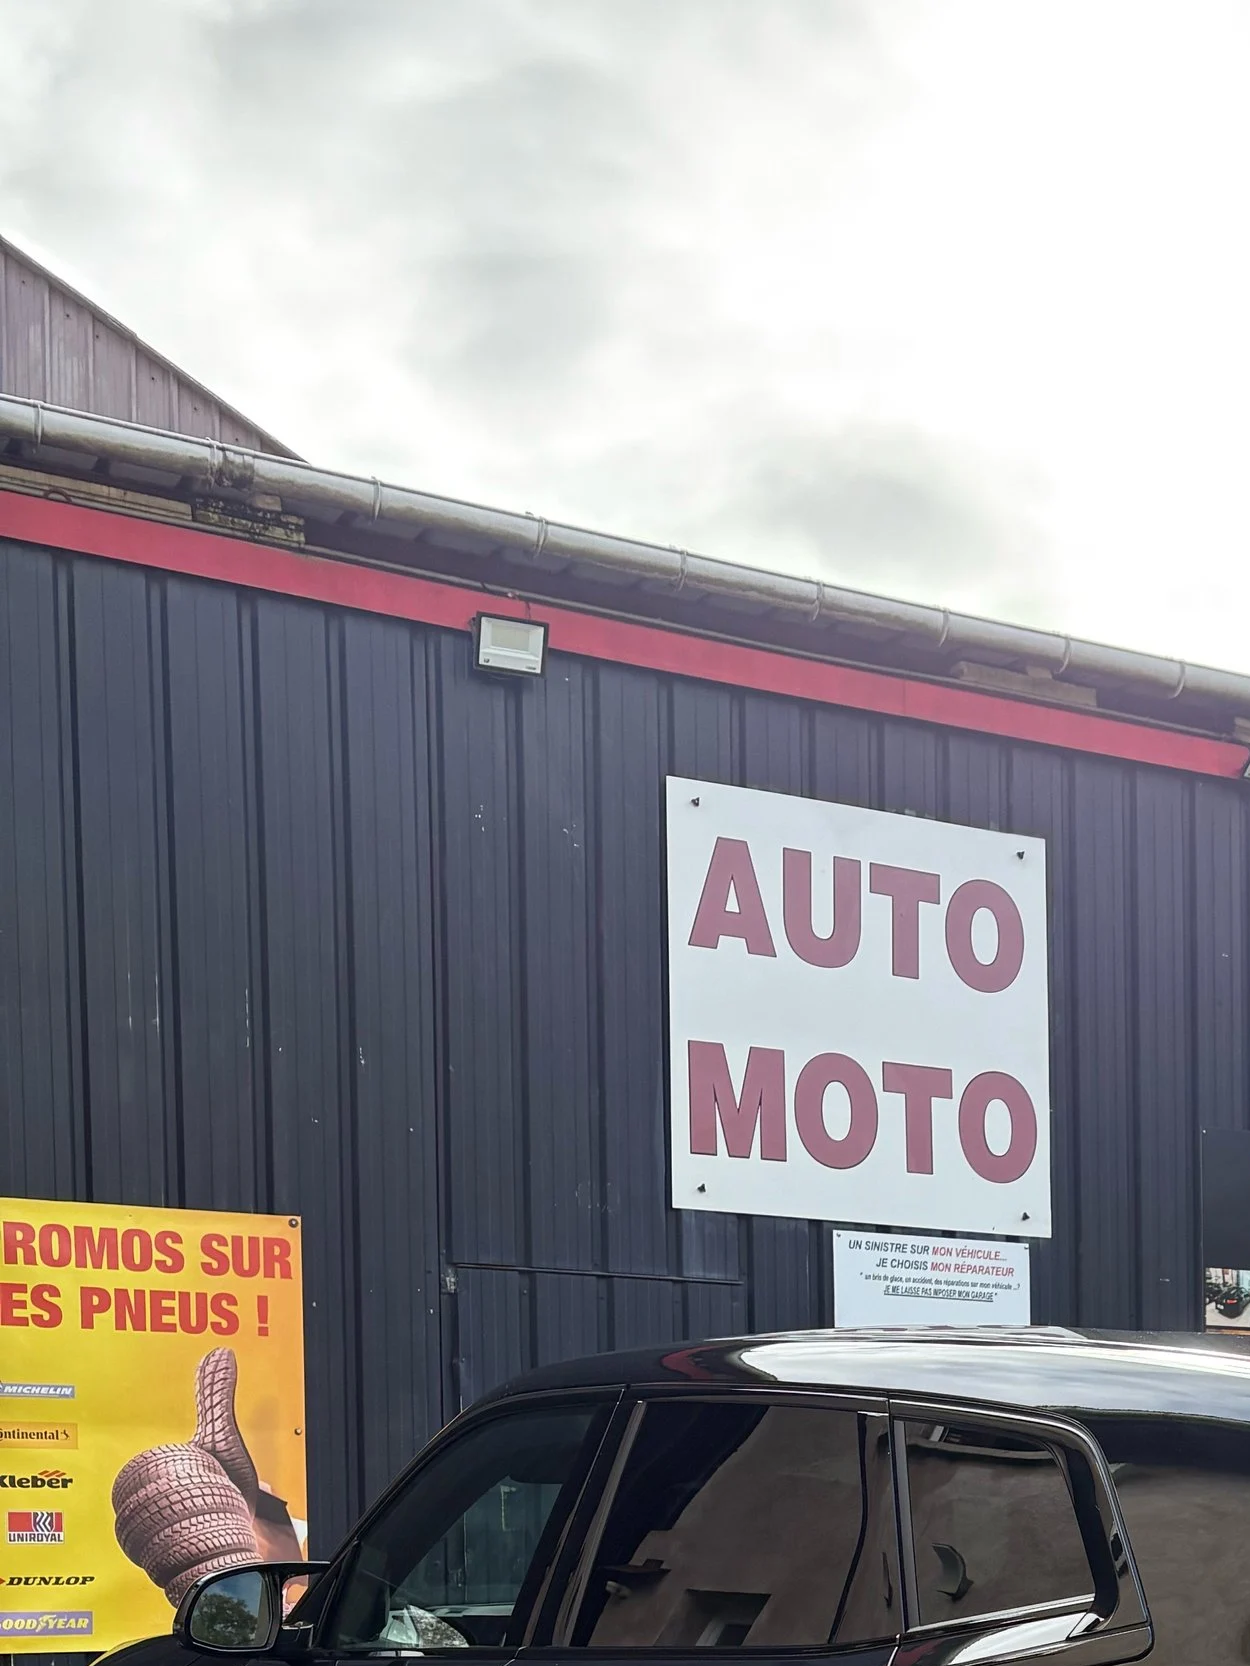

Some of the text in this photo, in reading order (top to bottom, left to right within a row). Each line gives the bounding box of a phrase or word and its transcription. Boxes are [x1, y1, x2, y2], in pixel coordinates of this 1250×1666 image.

[688, 836, 1025, 993] AUTO
[687, 1039, 1038, 1184] MOTO
[0, 1220, 293, 1281] ROMOS SUR
[848, 1239, 863, 1251] UN
[864, 1240, 908, 1254] SINISTRE
[909, 1244, 930, 1256] SUR
[931, 1246, 953, 1258] MON
[875, 1257, 1015, 1278] JE CHOISIS MON RÉPARATEUR
[79, 1286, 240, 1336] PNEUS
[257, 1295, 269, 1337] !
[4, 1385, 73, 1396] MICHELIN
[8, 1532, 63, 1543] UNIROYAL
[6, 1576, 95, 1586] DUNLOP
[0, 1616, 89, 1632] OODYEAR
